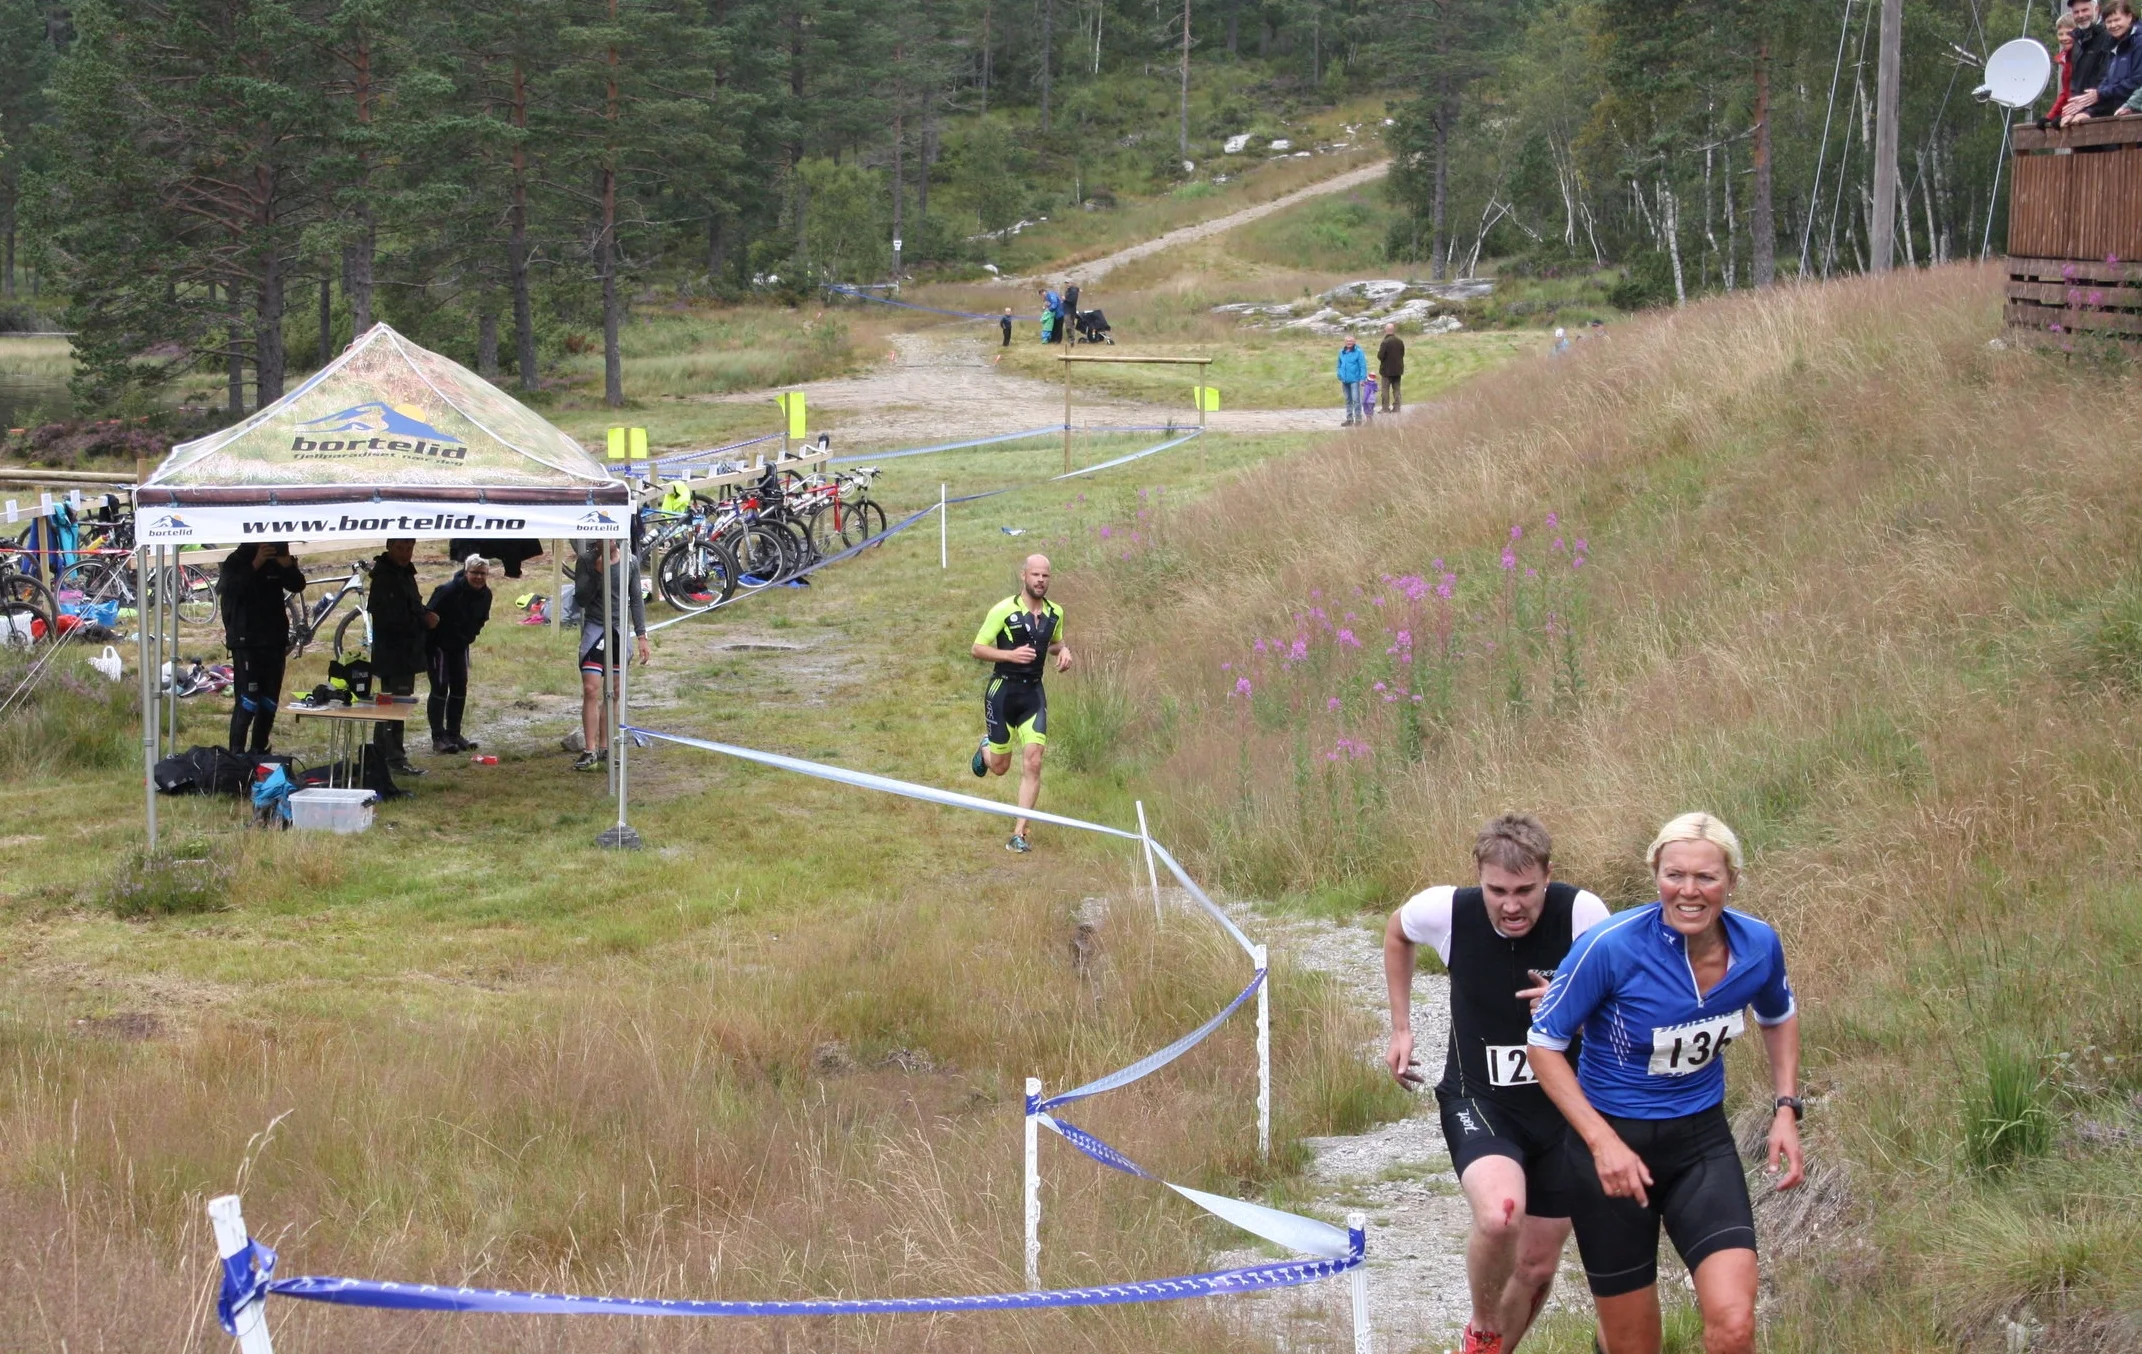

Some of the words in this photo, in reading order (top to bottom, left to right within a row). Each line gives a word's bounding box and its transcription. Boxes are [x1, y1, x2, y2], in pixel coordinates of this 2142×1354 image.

[291, 436, 467, 460] bortelid
[148, 528, 193, 537] bortelid
[242, 514, 527, 534] www.bortelid.no
[576, 524, 620, 532] bortelid
[1490, 1049, 1537, 1083] 12
